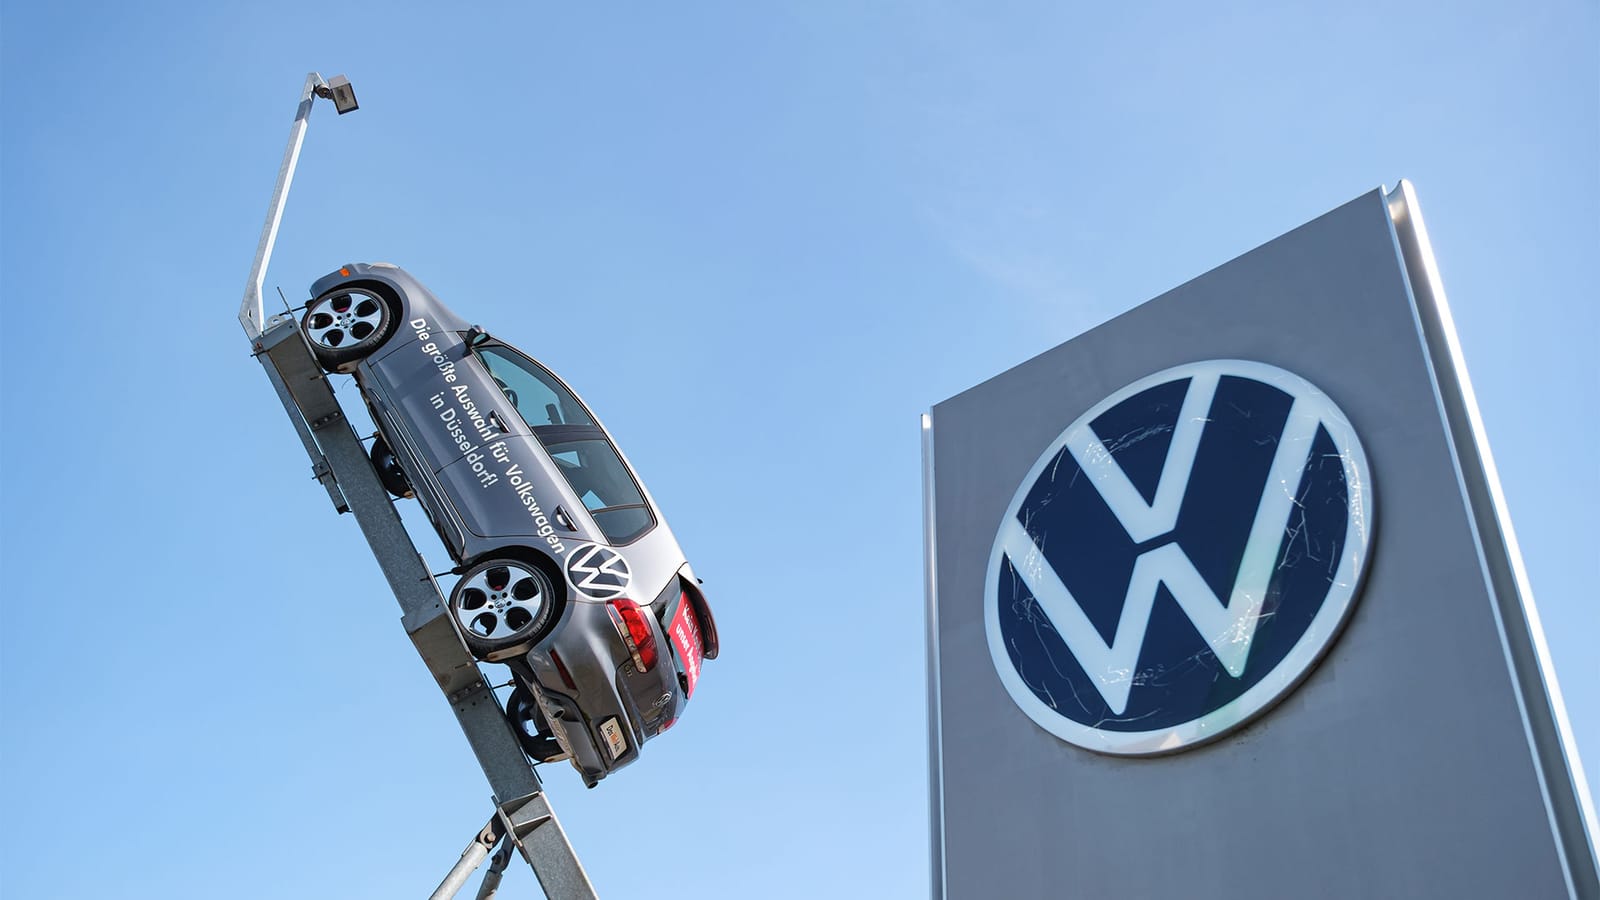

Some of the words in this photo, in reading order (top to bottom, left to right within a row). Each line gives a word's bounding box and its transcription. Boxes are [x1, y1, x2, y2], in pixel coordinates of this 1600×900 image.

[410, 318, 430, 341] Die
[421, 340, 457, 384] größte
[451, 383, 499, 442] Auswahl
[489, 441, 510, 463] für
[505, 464, 566, 554] Volkswagen
[430, 391, 447, 410] in
[440, 408, 499, 489] Düsseldorf!
[996, 366, 1328, 717] VW
